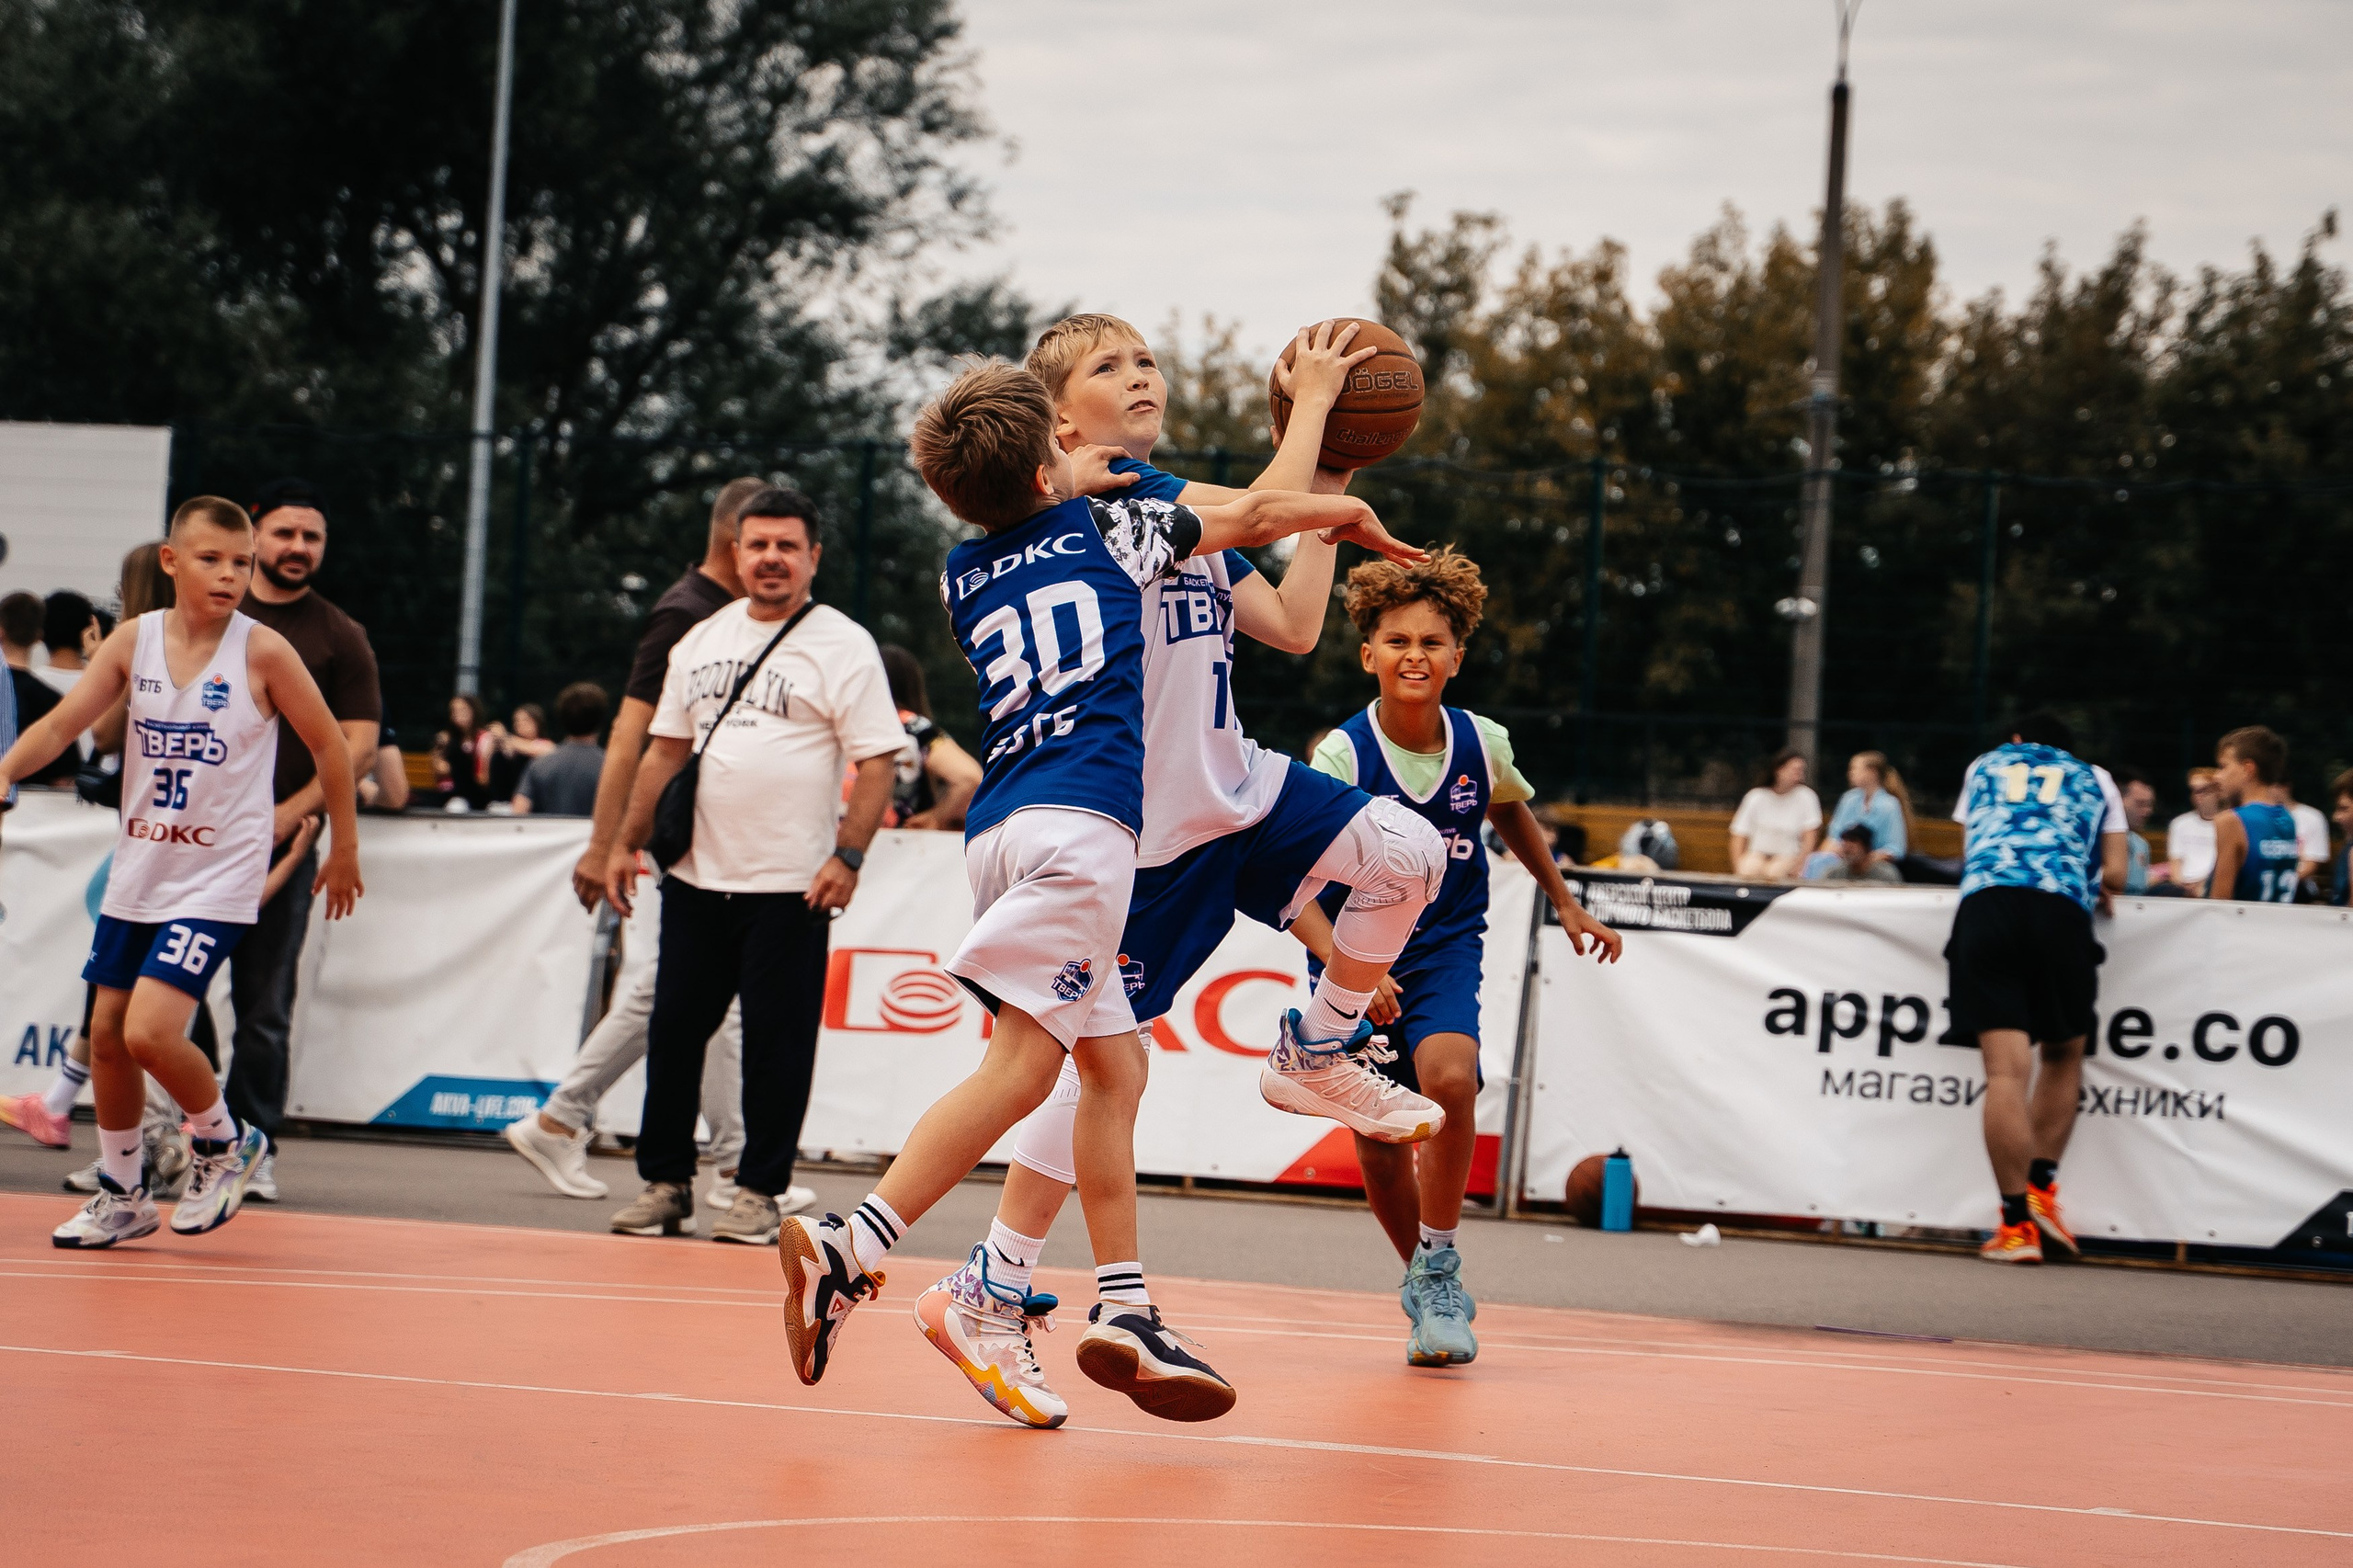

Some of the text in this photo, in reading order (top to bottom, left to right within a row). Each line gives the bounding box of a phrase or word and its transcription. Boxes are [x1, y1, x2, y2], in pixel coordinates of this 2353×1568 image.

[992, 533, 1086, 579] DKC
[971, 580, 1105, 722] 30
[136, 722, 226, 764] ТВЕРЬ
[153, 767, 193, 811] 36
[1999, 762, 2065, 804] 17
[1449, 799, 1478, 811] ТВЕРЬ
[150, 823, 216, 847] DKC
[157, 924, 217, 975] 36
[1764, 985, 2302, 1067] appe.co
[1820, 1066, 1987, 1107] магази
